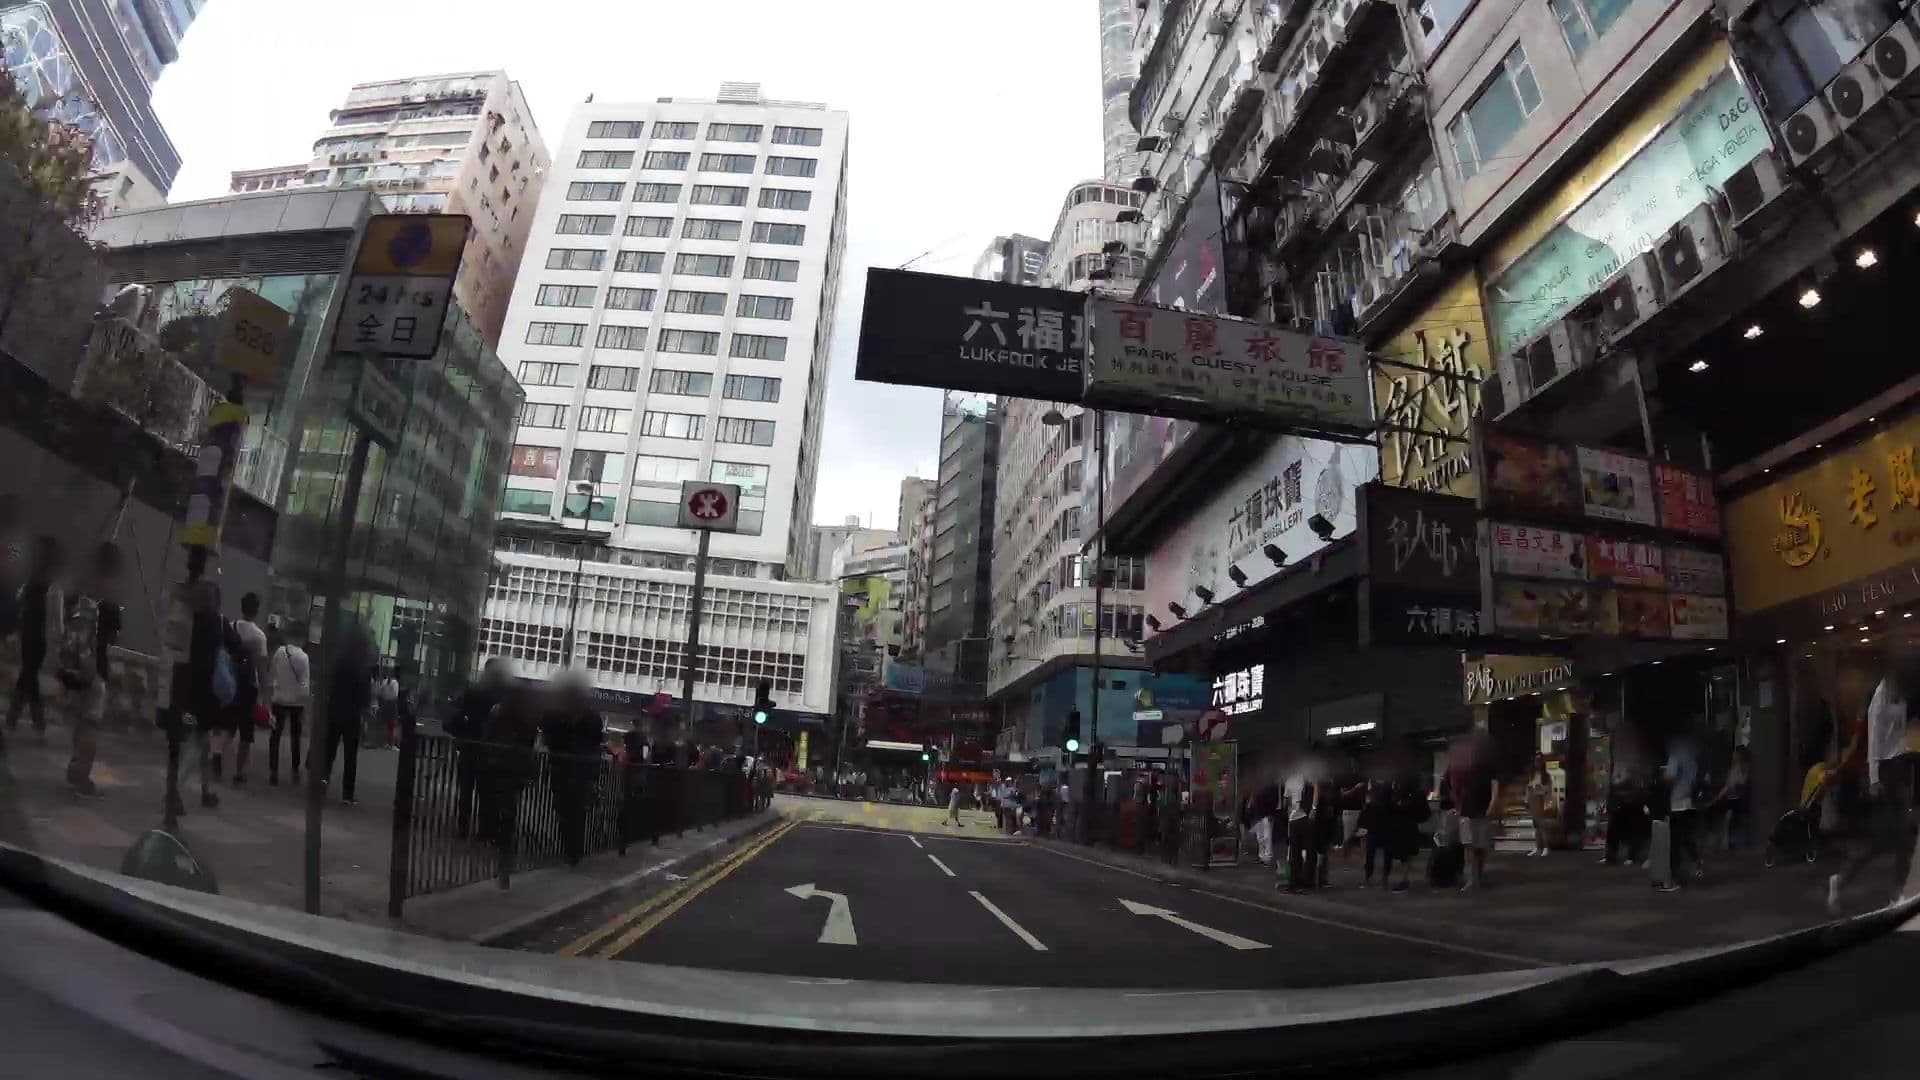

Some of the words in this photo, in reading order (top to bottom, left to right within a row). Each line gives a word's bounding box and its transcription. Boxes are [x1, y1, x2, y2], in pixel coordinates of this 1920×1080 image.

[1719, 97, 1749, 131] D&G
[355, 313, 417, 344] 全日
[1125, 346, 1178, 362] PARK
[1228, 458, 1303, 549] 六福珠寶
[1862, 579, 1897, 604] FENG
